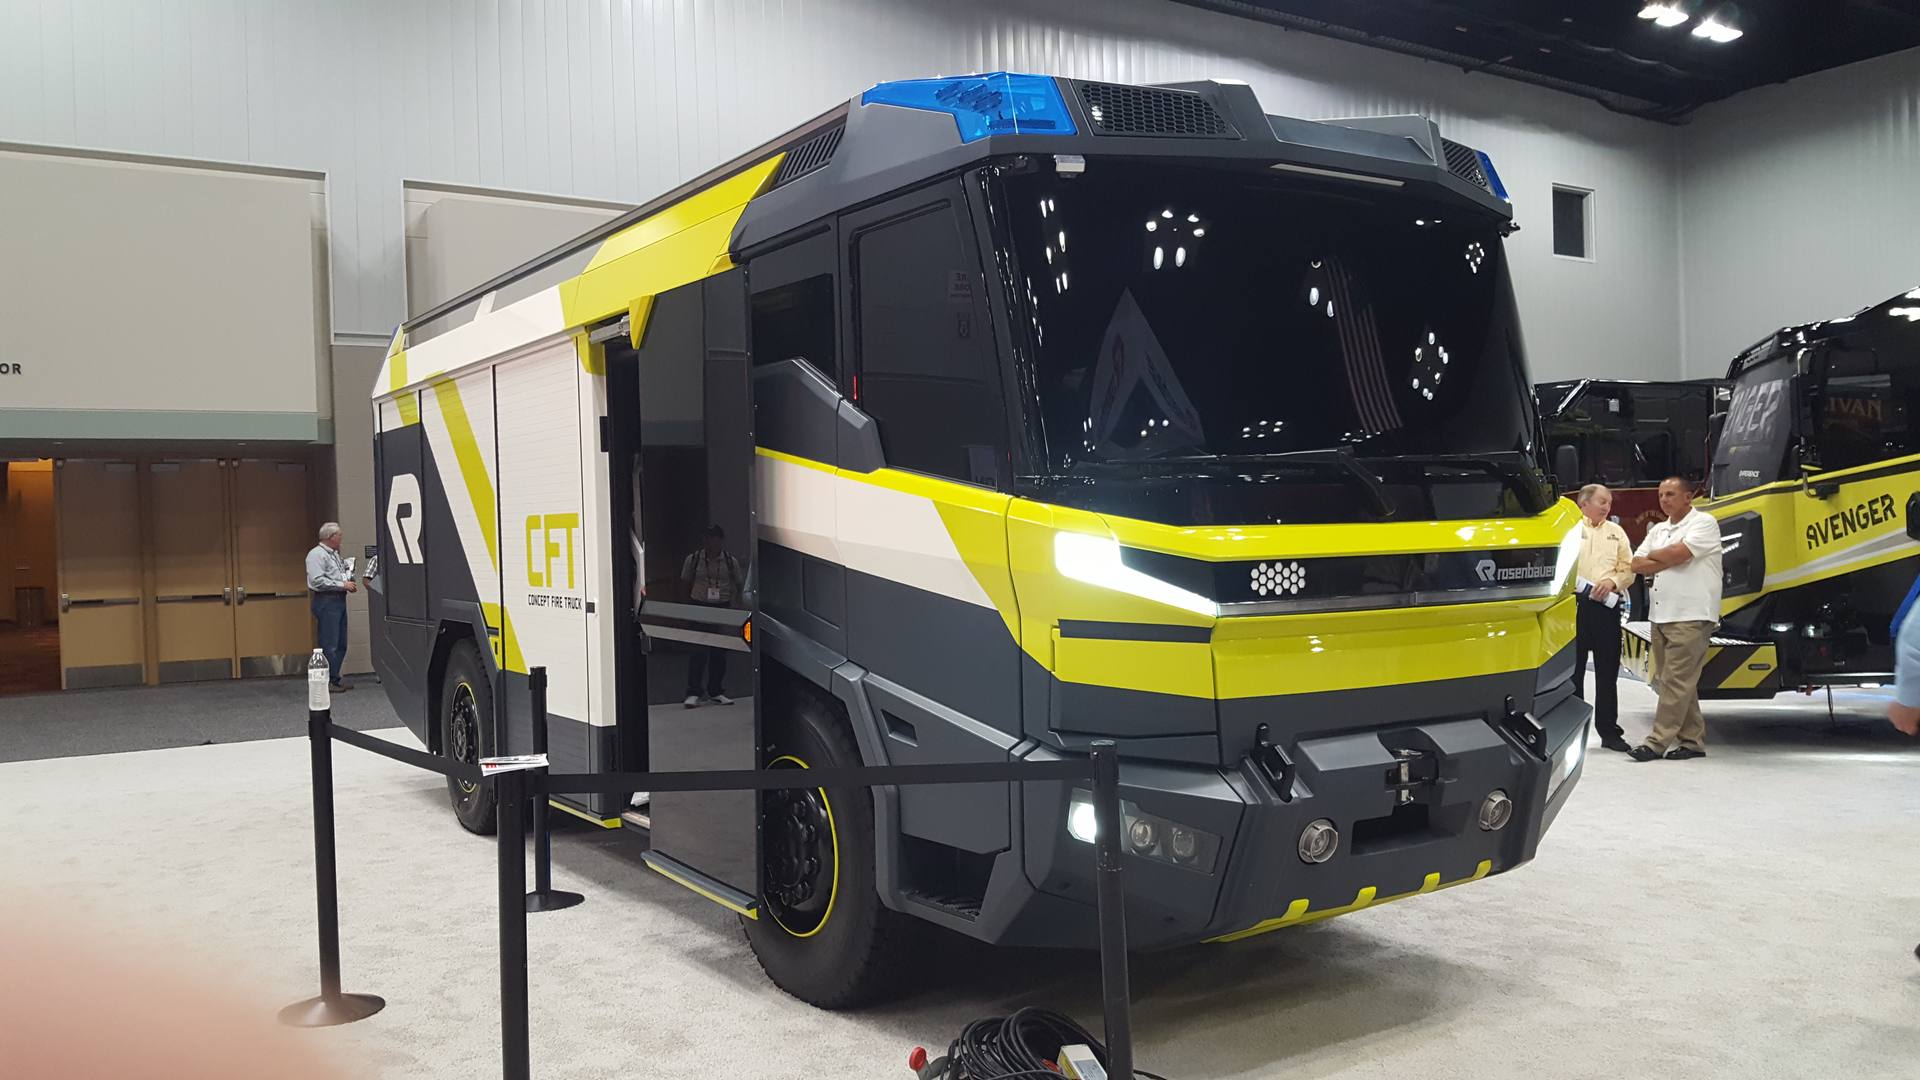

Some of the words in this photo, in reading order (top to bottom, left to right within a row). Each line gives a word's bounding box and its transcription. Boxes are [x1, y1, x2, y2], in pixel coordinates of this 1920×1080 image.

[1806, 494, 1897, 550] AVENGER
[526, 513, 579, 589] CFT
[1497, 562, 1556, 580] rosenbauer
[528, 594, 550, 607] CONCEPT
[551, 596, 563, 608] FIRE
[564, 597, 583, 610] TRUCK
